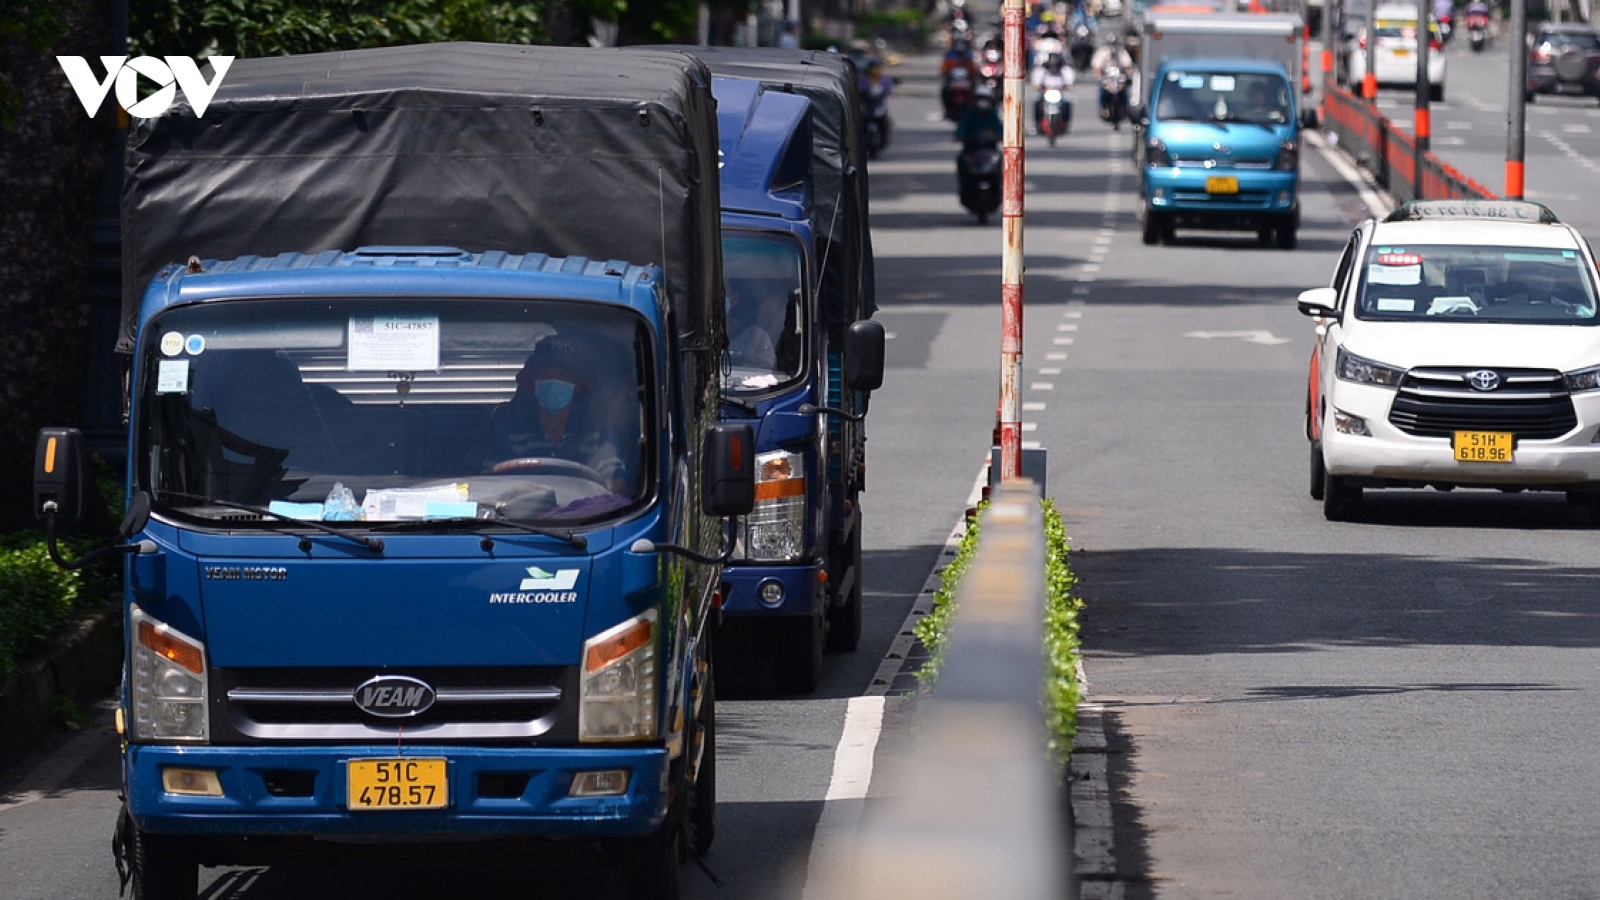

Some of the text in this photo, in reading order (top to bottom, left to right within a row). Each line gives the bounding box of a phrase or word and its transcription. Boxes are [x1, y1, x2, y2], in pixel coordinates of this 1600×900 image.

[384, 321, 434, 332] 51C-47857
[1471, 434, 1496, 446] 51H
[1460, 447, 1506, 460] 618.96
[243, 566, 287, 580] MOTOR
[489, 591, 578, 604] INTERCOOLER
[362, 686, 426, 707] VEAM
[376, 762, 418, 782] 51C
[359, 785, 437, 806] 478.57
